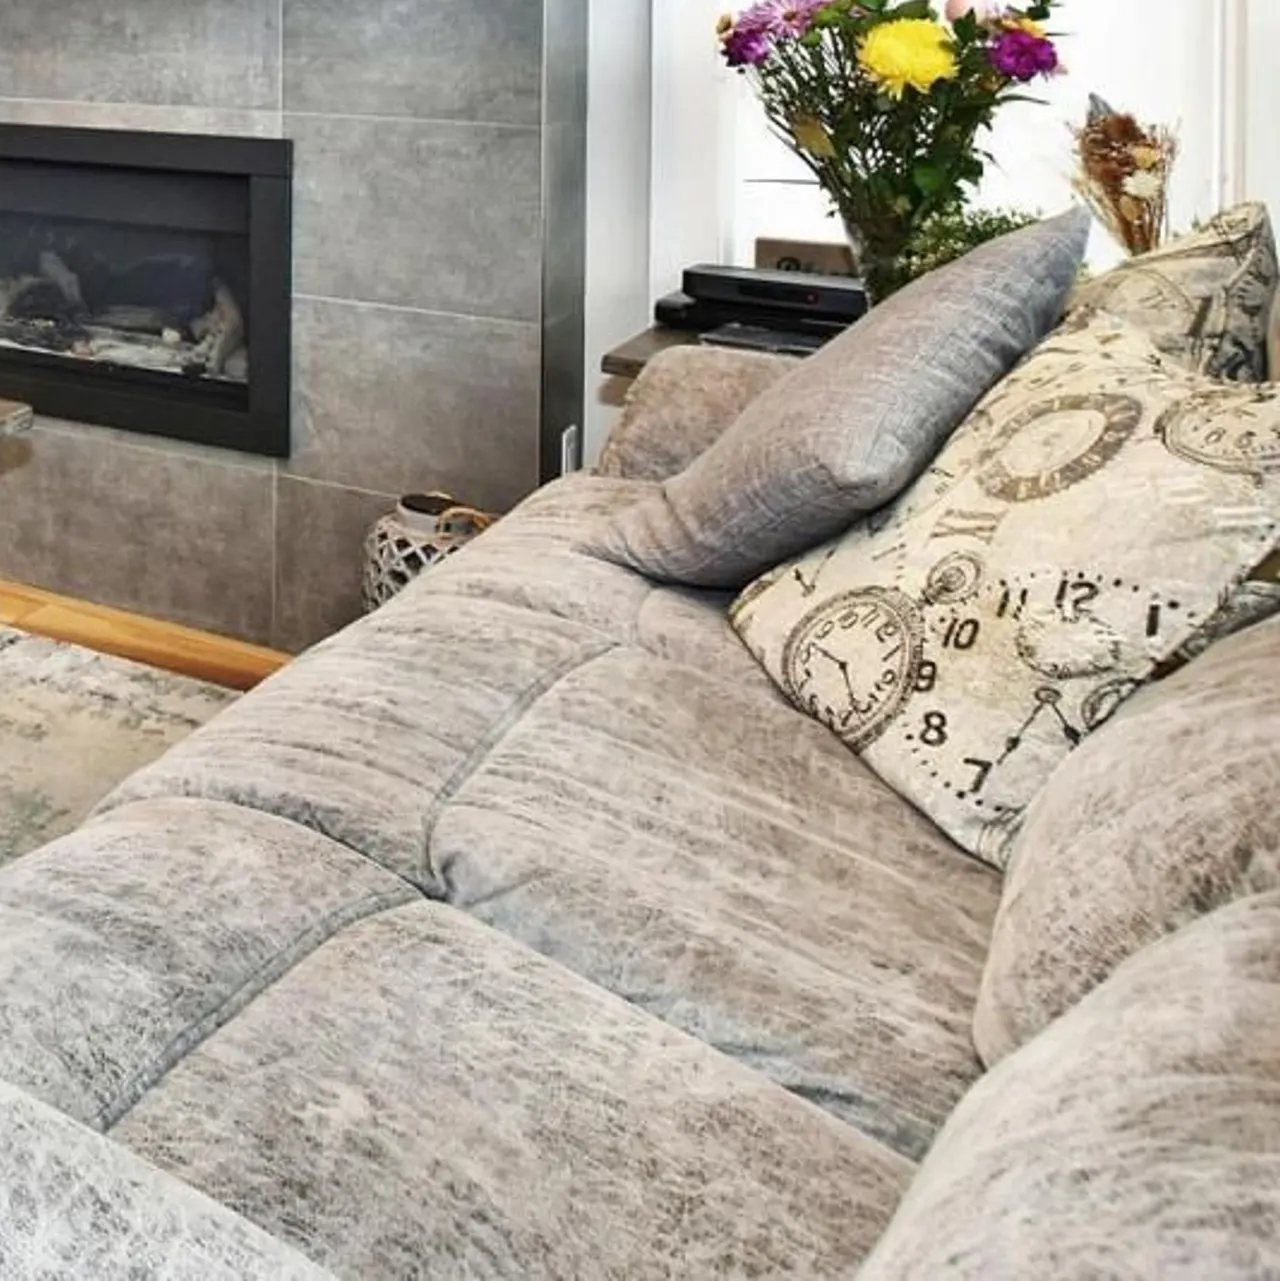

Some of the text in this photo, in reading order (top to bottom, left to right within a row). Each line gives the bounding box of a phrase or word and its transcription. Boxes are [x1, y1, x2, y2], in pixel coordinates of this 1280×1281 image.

[1054, 579, 1099, 618] 12
[942, 618, 980, 650] 10
[913, 660, 938, 692] 9
[919, 710, 948, 747] 8
[963, 757, 994, 793] 7
